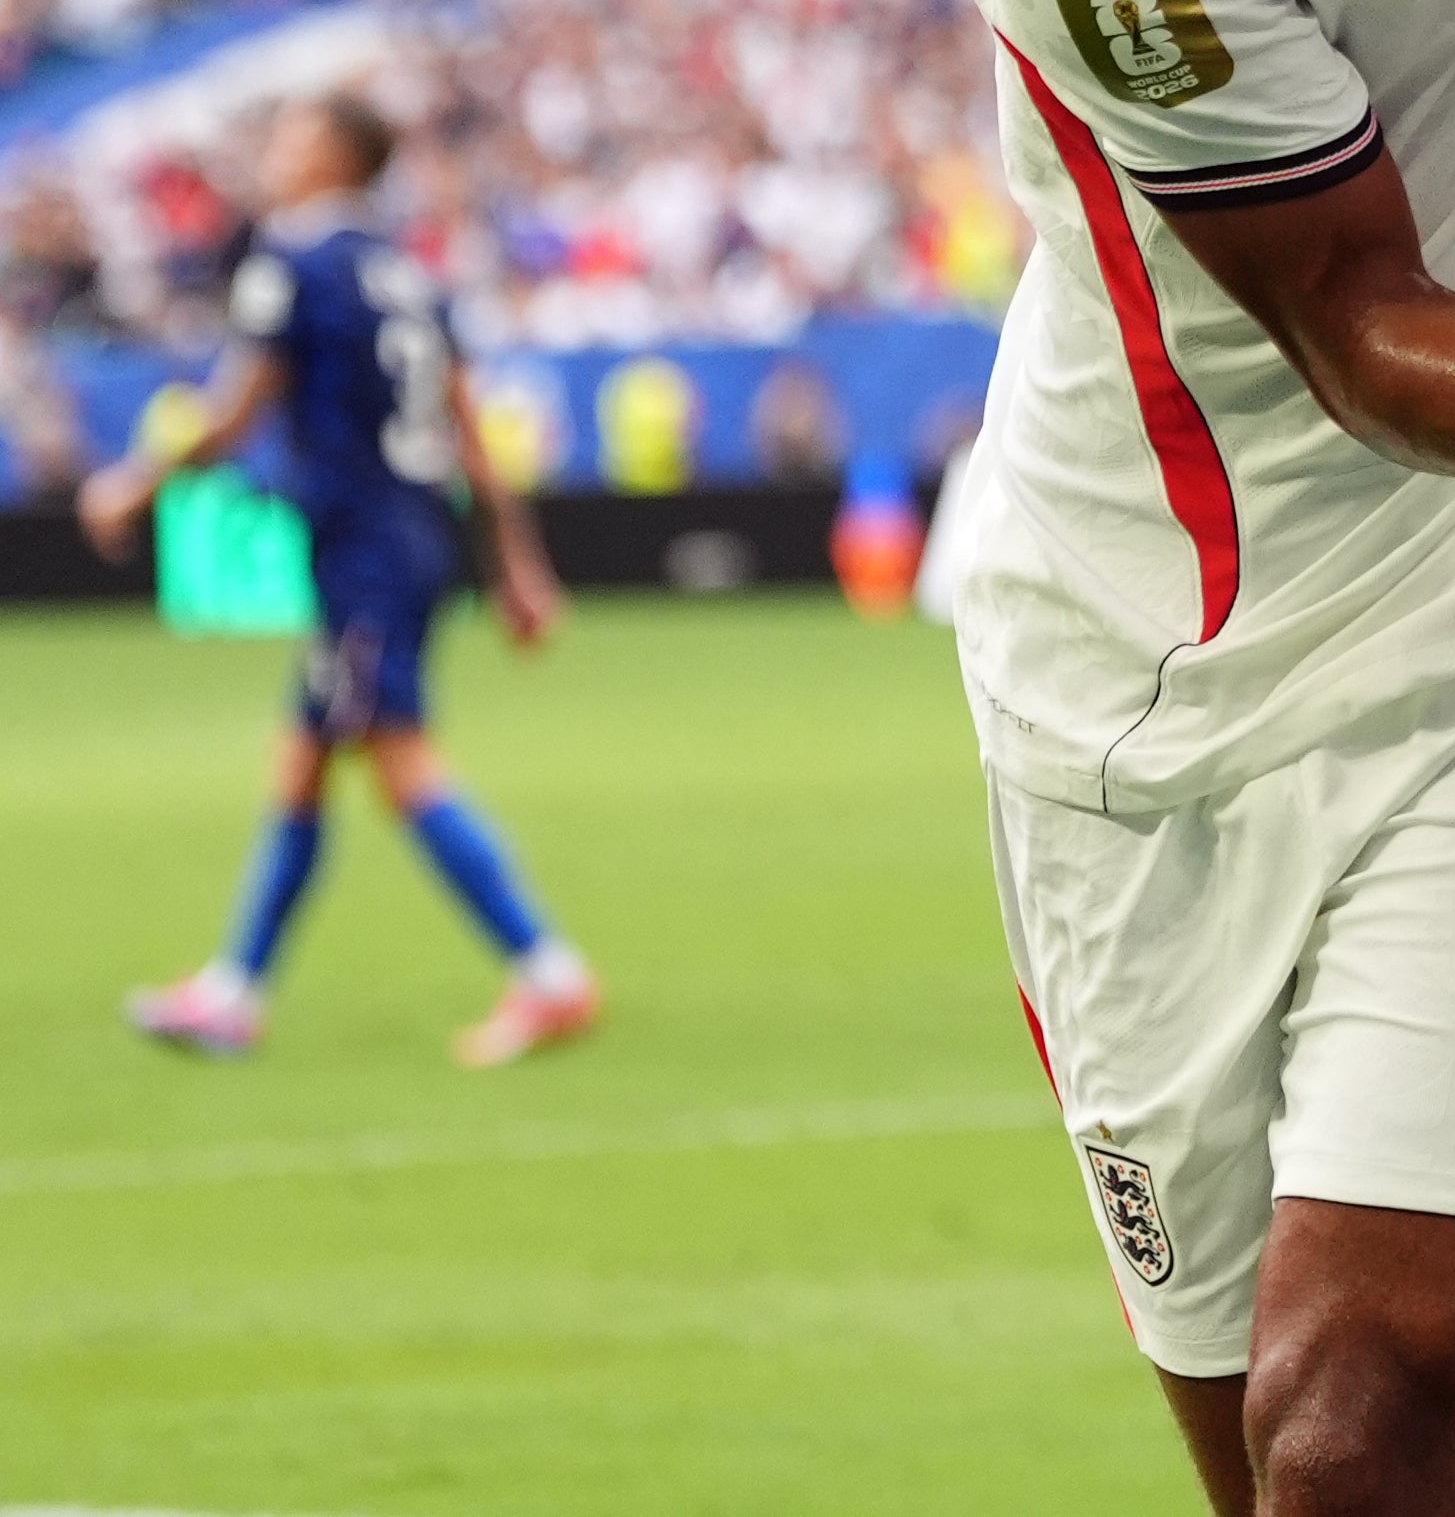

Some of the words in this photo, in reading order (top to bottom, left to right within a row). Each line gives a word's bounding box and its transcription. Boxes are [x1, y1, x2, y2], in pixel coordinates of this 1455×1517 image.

[1135, 53, 1166, 69] FIFA
[1126, 70, 1168, 89] WORLD
[1168, 64, 1192, 80] CUP
[1133, 74, 1200, 101] 2026
